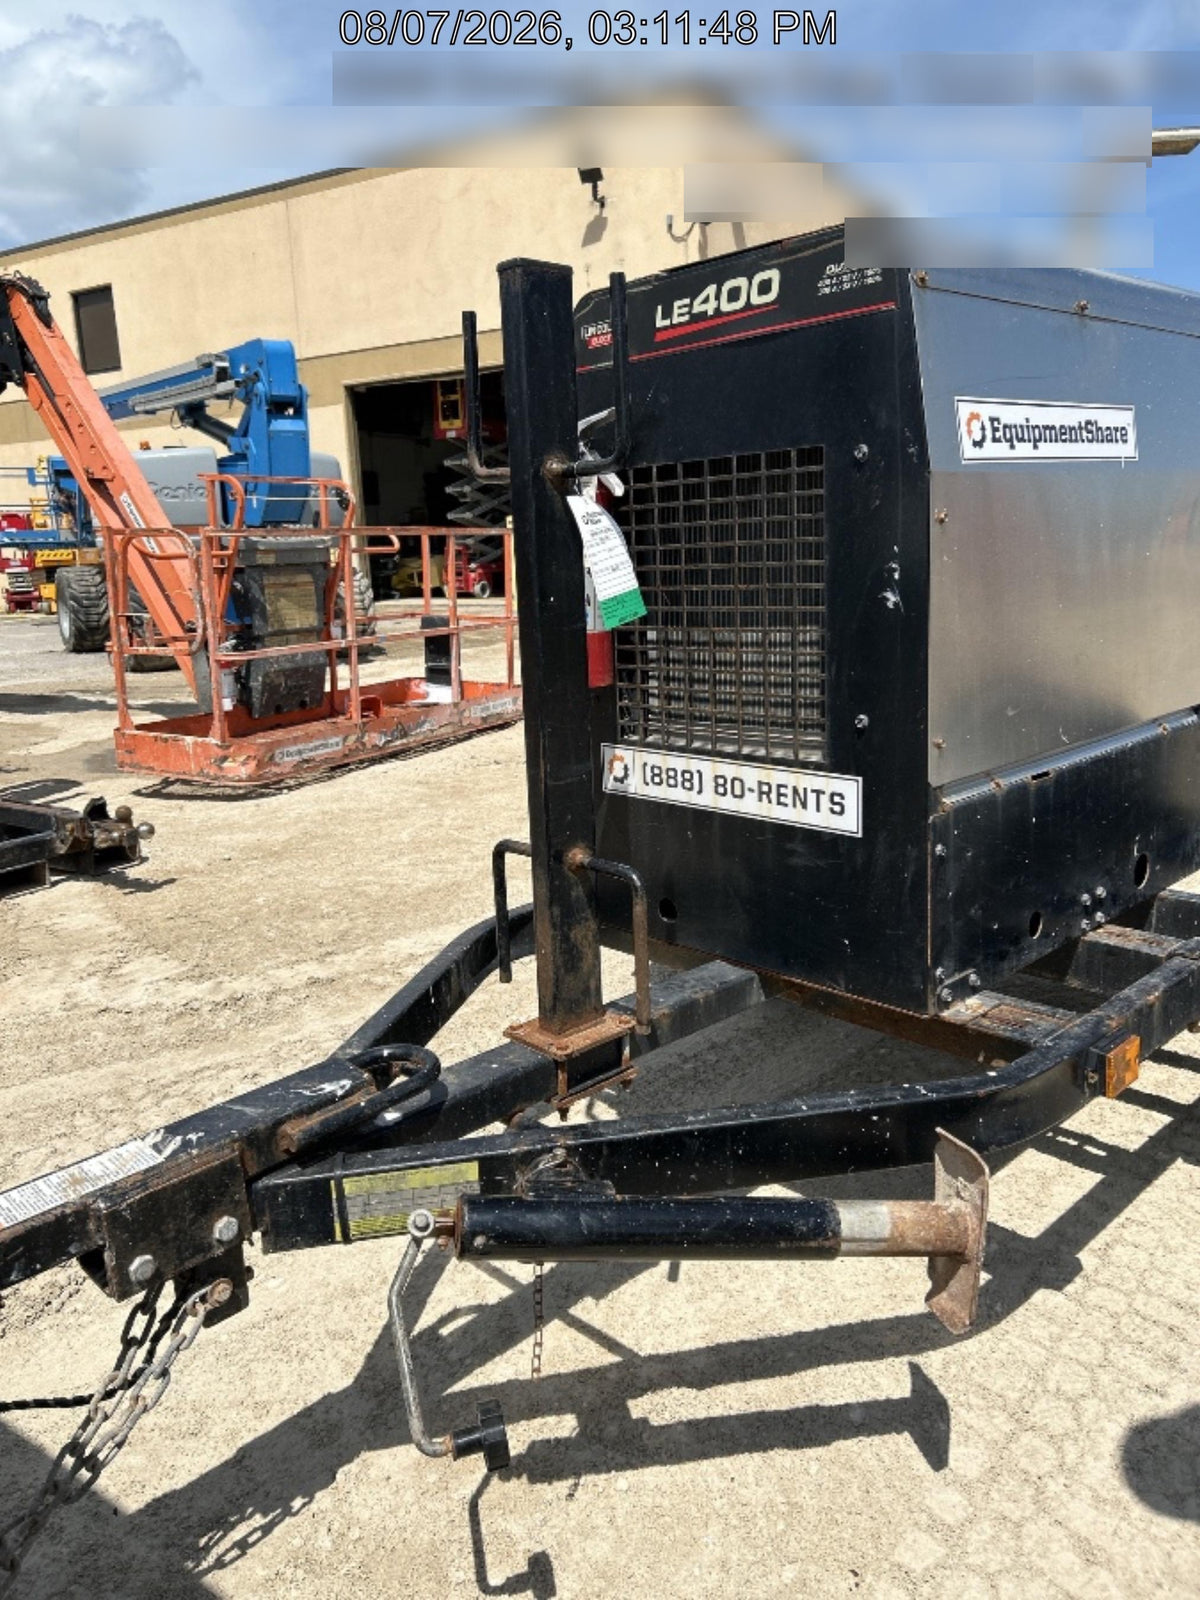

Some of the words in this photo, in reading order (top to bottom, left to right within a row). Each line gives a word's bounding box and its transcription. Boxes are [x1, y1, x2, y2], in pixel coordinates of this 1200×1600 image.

[655, 268, 780, 329] LE400
[988, 415, 1129, 450] EquipmentShare
[642, 761, 704, 796] (888)
[713, 774, 846, 817] 80-RENTS
